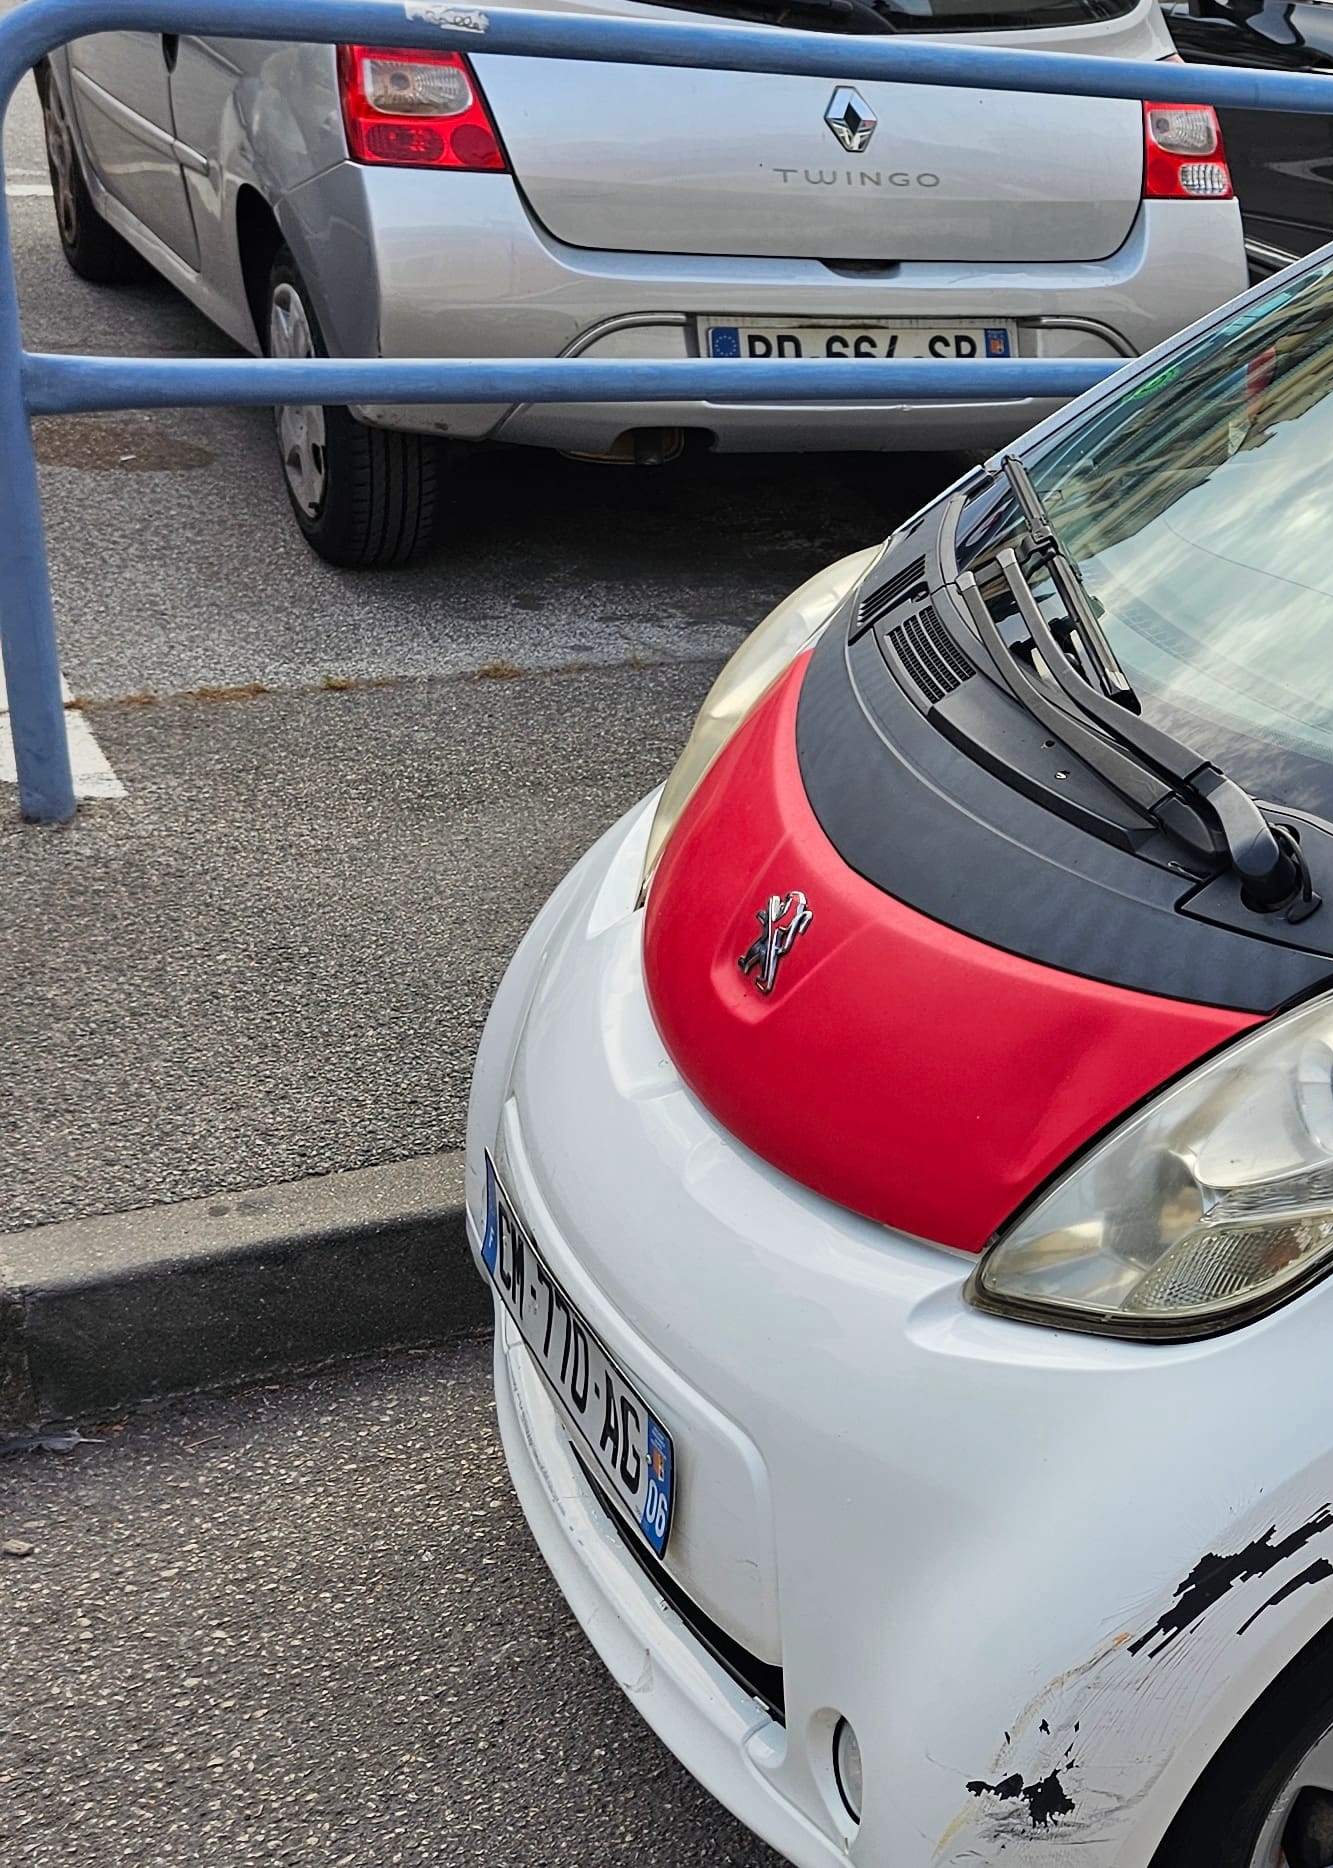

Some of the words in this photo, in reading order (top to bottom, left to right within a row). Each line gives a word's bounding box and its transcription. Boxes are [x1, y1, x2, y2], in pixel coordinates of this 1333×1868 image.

[772, 168, 940, 188] TWINGO
[488, 1226, 496, 1248] F
[645, 1479, 669, 1538] 06
